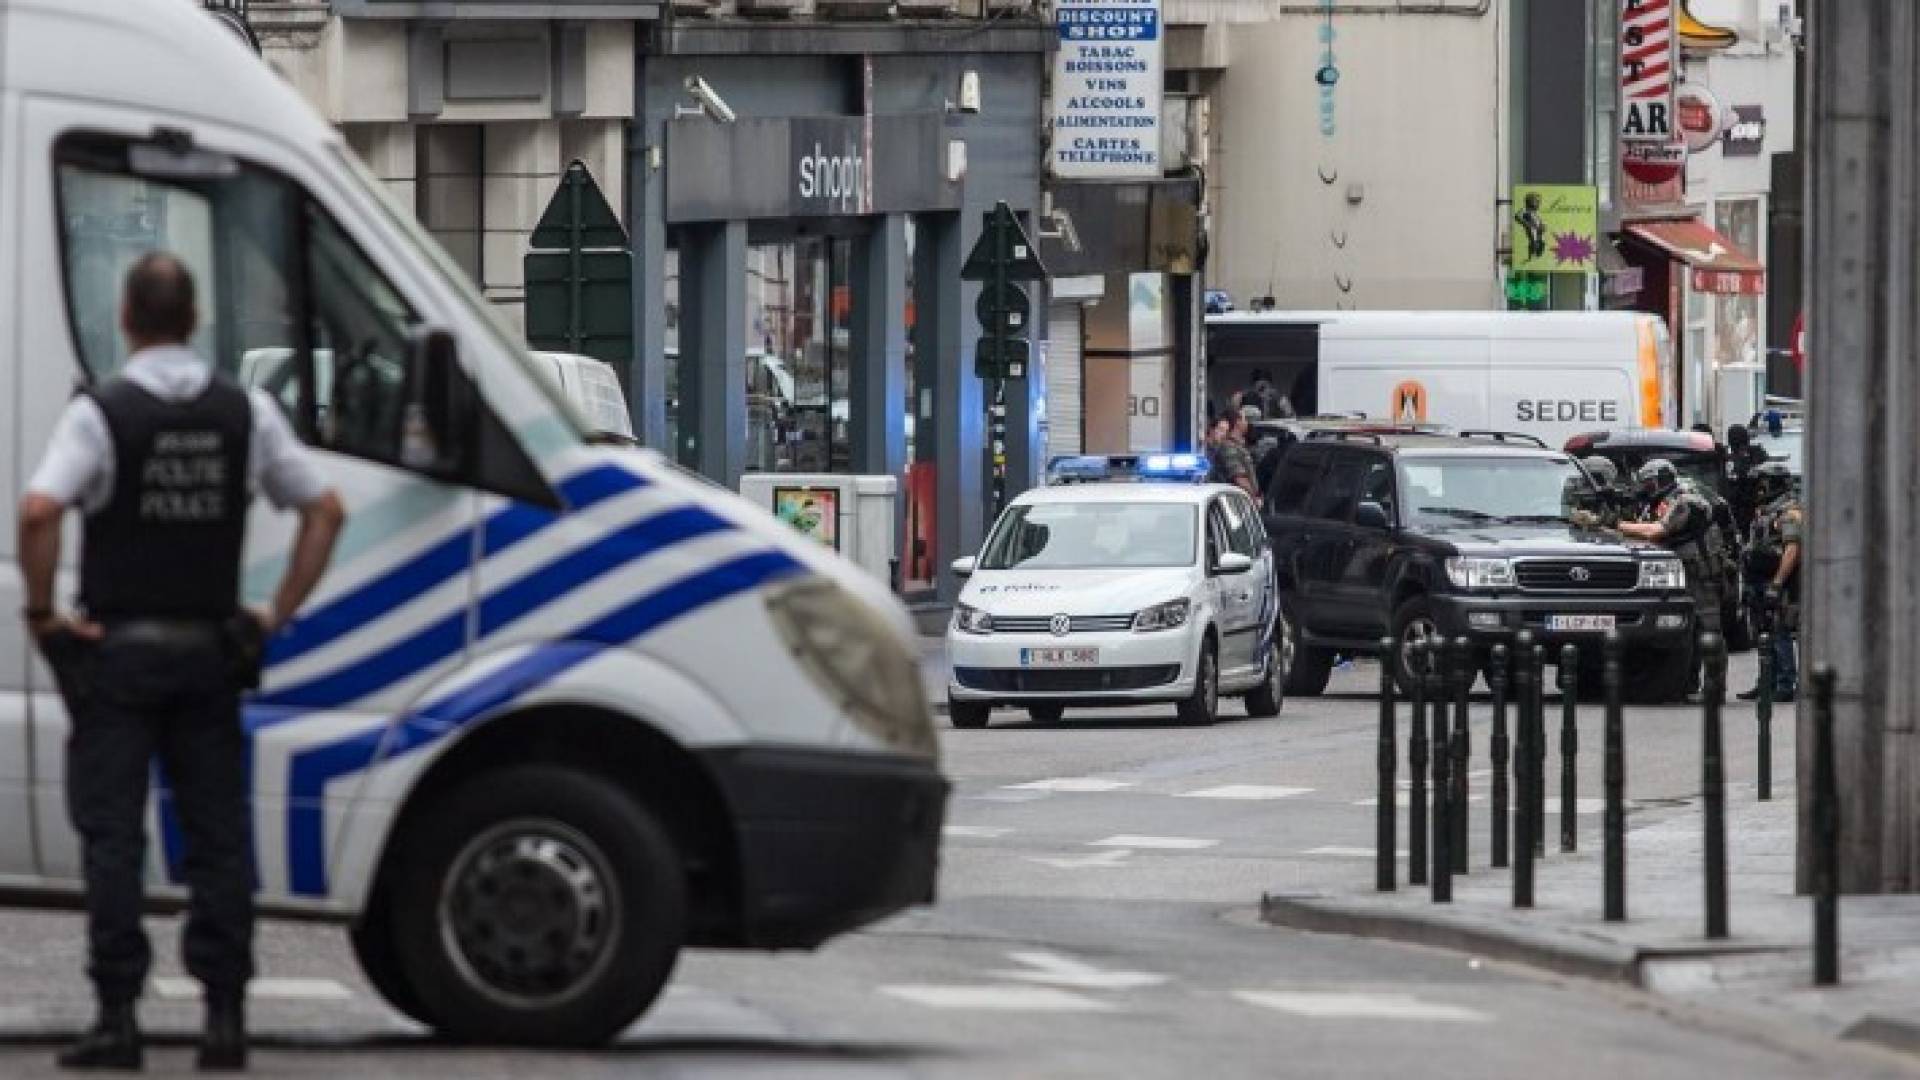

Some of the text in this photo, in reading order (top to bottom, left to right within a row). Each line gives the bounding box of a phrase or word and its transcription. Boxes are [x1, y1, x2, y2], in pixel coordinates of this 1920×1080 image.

[1058, 10, 1154, 23] DISCOUNT
[1068, 26, 1143, 37] SHOP
[1079, 46, 1135, 58] TABAC
[1065, 61, 1147, 73] BOISSONS
[1085, 79, 1127, 90] VINS
[1067, 96, 1146, 109] ALCOOLS
[1055, 115, 1155, 128] ALIMENTATION
[1073, 137, 1141, 150] CARTES
[1058, 150, 1156, 163] TELEPHONE
[1516, 399, 1618, 422] SEDEE
